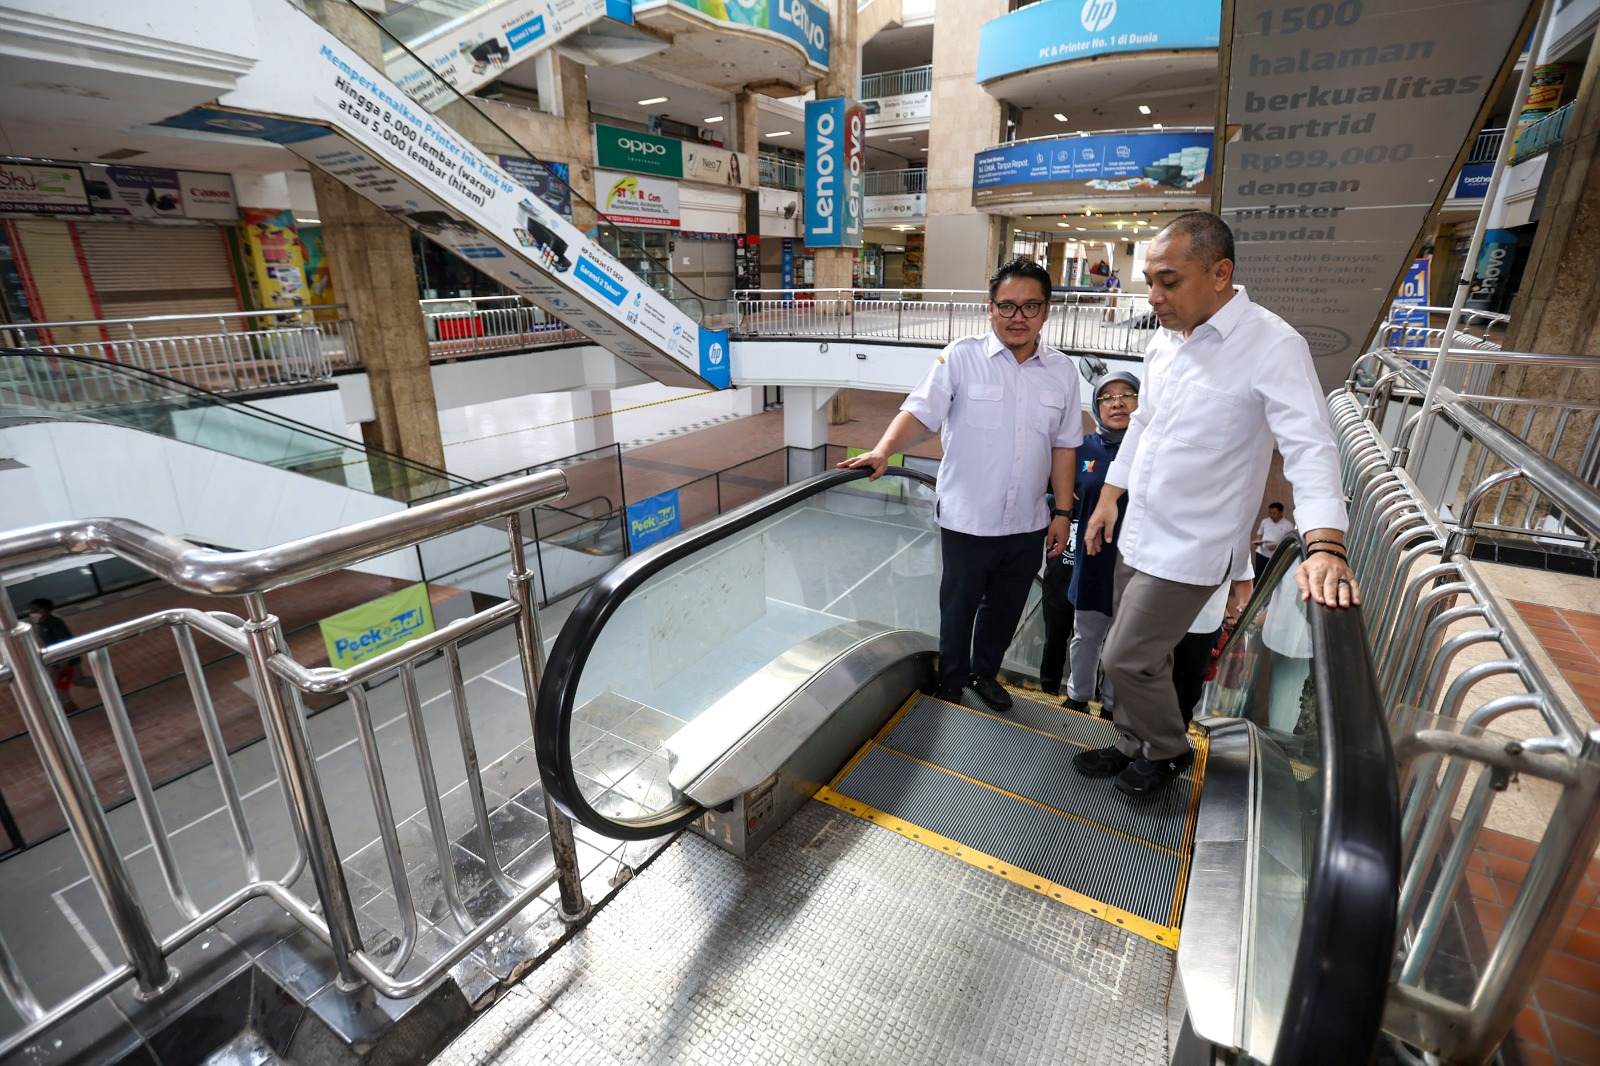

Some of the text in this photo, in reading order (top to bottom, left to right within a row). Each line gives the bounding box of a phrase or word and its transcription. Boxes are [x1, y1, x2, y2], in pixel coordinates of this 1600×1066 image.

[1083, 0, 1115, 32] hp
[1256, 0, 1363, 37] 1500
[1039, 47, 1049, 58] PC
[1059, 39, 1090, 55] Printer
[1091, 37, 1109, 49] No.
[1110, 35, 1116, 45] 1
[1118, 34, 1128, 45] di
[1129, 32, 1158, 45] Dunia
[1248, 40, 1436, 77] halaman
[1244, 75, 1484, 113] berkualitas
[320, 44, 423, 129] Memperkenalkan
[424, 123, 460, 156] Printer
[460, 147, 477, 169] Ink
[479, 161, 500, 187] Tank
[500, 181, 514, 195] HP
[1242, 112, 1377, 142] Kartrid
[335, 75, 381, 117] Hingga
[383, 111, 417, 142] 8.000
[418, 135, 458, 171] lembar
[458, 164, 496, 200] (warna)
[617, 137, 667, 156] oppo
[338, 99, 370, 127] atau
[371, 121, 406, 151] 5.000
[408, 145, 447, 180] lembar
[448, 174, 486, 208] (hitam)
[812, 113, 835, 235] Lenovo
[846, 114, 865, 235] Lenovo
[190, 188, 231, 199] Canon
[1238, 179, 1361, 198] dengan
[1235, 204, 1347, 222] printer
[1233, 227, 1337, 242] handal
[1236, 254, 1271, 263] etak
[1276, 254, 1317, 263] Lebih
[1284, 265, 1314, 274] dan
[579, 264, 600, 282] Garansi
[1284, 276, 1304, 284] HP
[710, 343, 722, 364] hp
[1062, 557, 1077, 566] Gra
